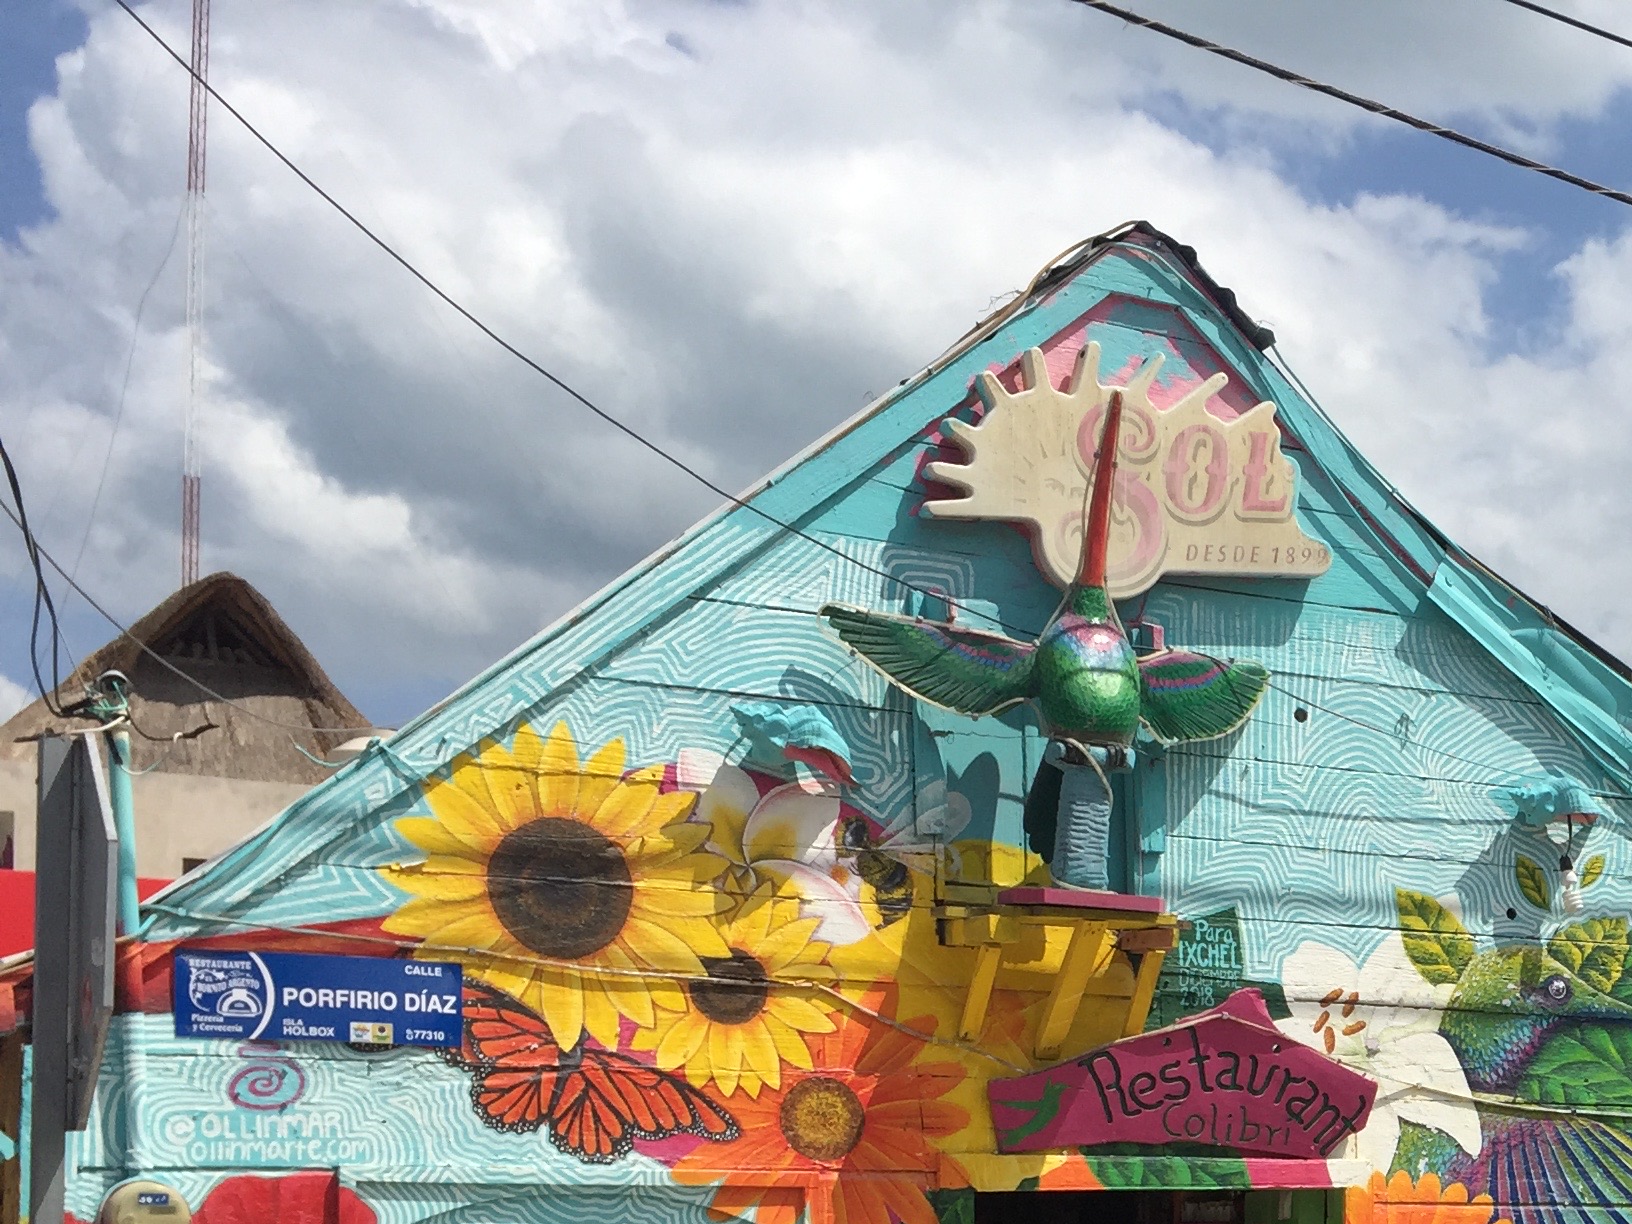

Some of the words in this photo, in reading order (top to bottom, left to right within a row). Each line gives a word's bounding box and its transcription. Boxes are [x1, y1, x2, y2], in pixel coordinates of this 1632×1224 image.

[1053, 402, 1289, 582] SOL
[1185, 544, 1261, 564] DESDE
[1271, 546, 1331, 565] 1899
[1193, 919, 1235, 944] Para
[188, 958, 252, 970] RESTAURANTE
[1178, 940, 1243, 969] IXCHEL
[404, 964, 443, 977] CALLE
[282, 987, 398, 1011] PORFIRIO
[404, 989, 457, 1015] DÍAZ
[1180, 986, 1215, 1007] 2018
[282, 1018, 304, 1026] ISLA
[282, 1025, 336, 1037] HOLBOX
[413, 1029, 445, 1041] 77310
[1078, 1026, 1367, 1158] Restaurant
